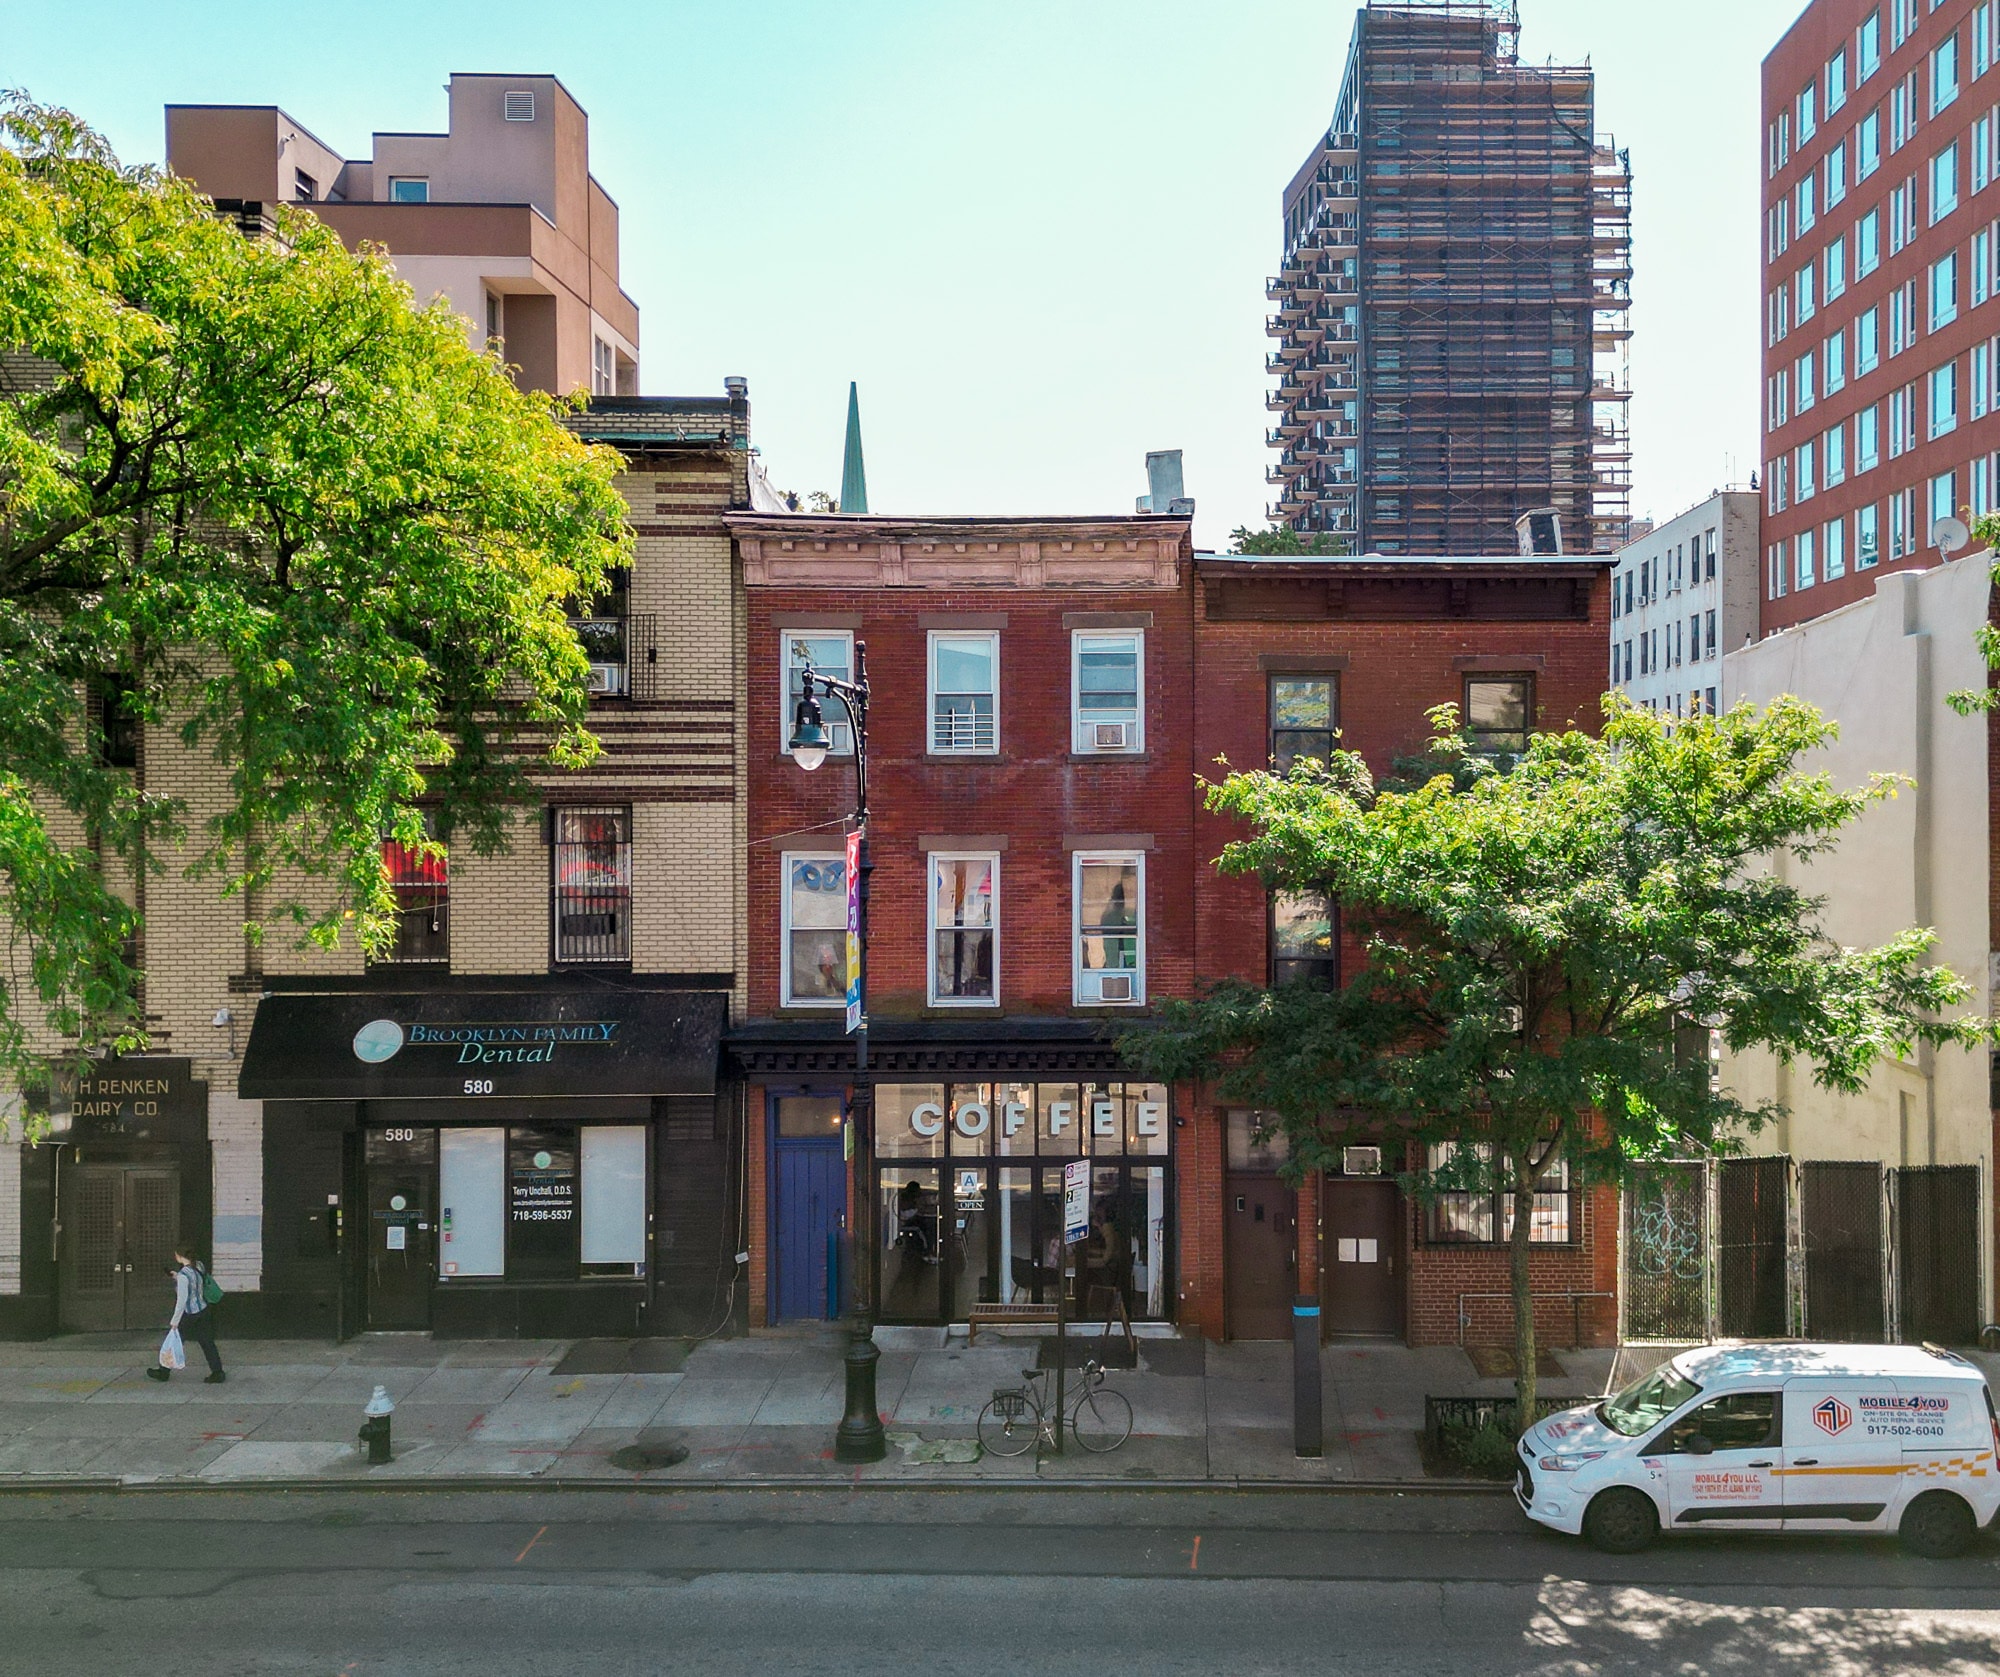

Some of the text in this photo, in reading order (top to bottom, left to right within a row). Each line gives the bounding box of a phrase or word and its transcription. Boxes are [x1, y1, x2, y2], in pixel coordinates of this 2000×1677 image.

[409, 1023, 616, 1042] BROOKLYN FAMILY
[457, 1042, 554, 1064] Dental
[98, 1080, 169, 1094] RENKEN
[463, 1079, 493, 1094] 580
[71, 1101, 123, 1116] DAIRY
[911, 1102, 1159, 1137] COFFEE
[385, 1128, 413, 1141] 580
[964, 1175, 974, 1187] A
[513, 1186, 528, 1197] Terry
[1066, 1191, 1072, 1203] 2
[960, 1201, 983, 1209] OPEN
[513, 1210, 572, 1220] 718-596-5537
[1917, 1417, 1945, 1425] SERVICE
[1867, 1425, 1944, 1436] 917-502-6040
